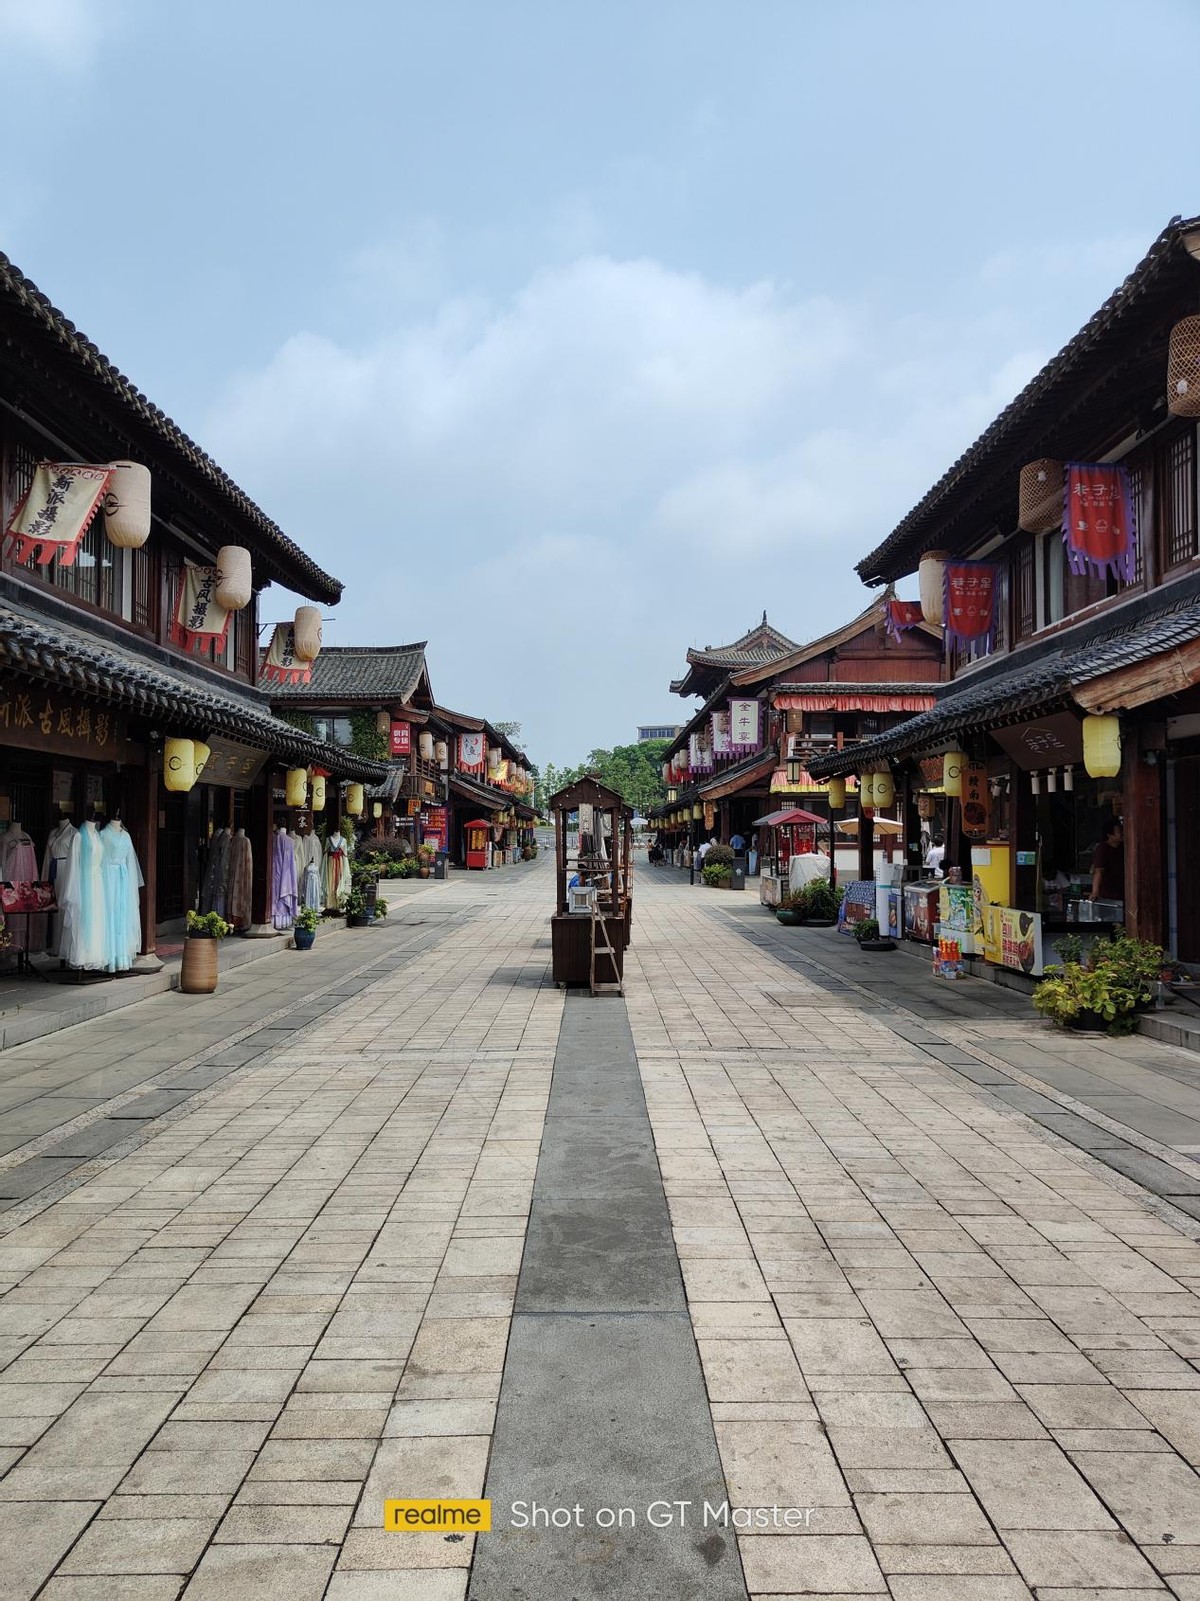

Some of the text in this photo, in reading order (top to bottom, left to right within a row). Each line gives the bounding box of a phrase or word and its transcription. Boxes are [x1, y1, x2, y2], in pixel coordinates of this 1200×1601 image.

[188, 575, 216, 630] 古风摄影
[738, 702, 751, 741] 金牛宴
